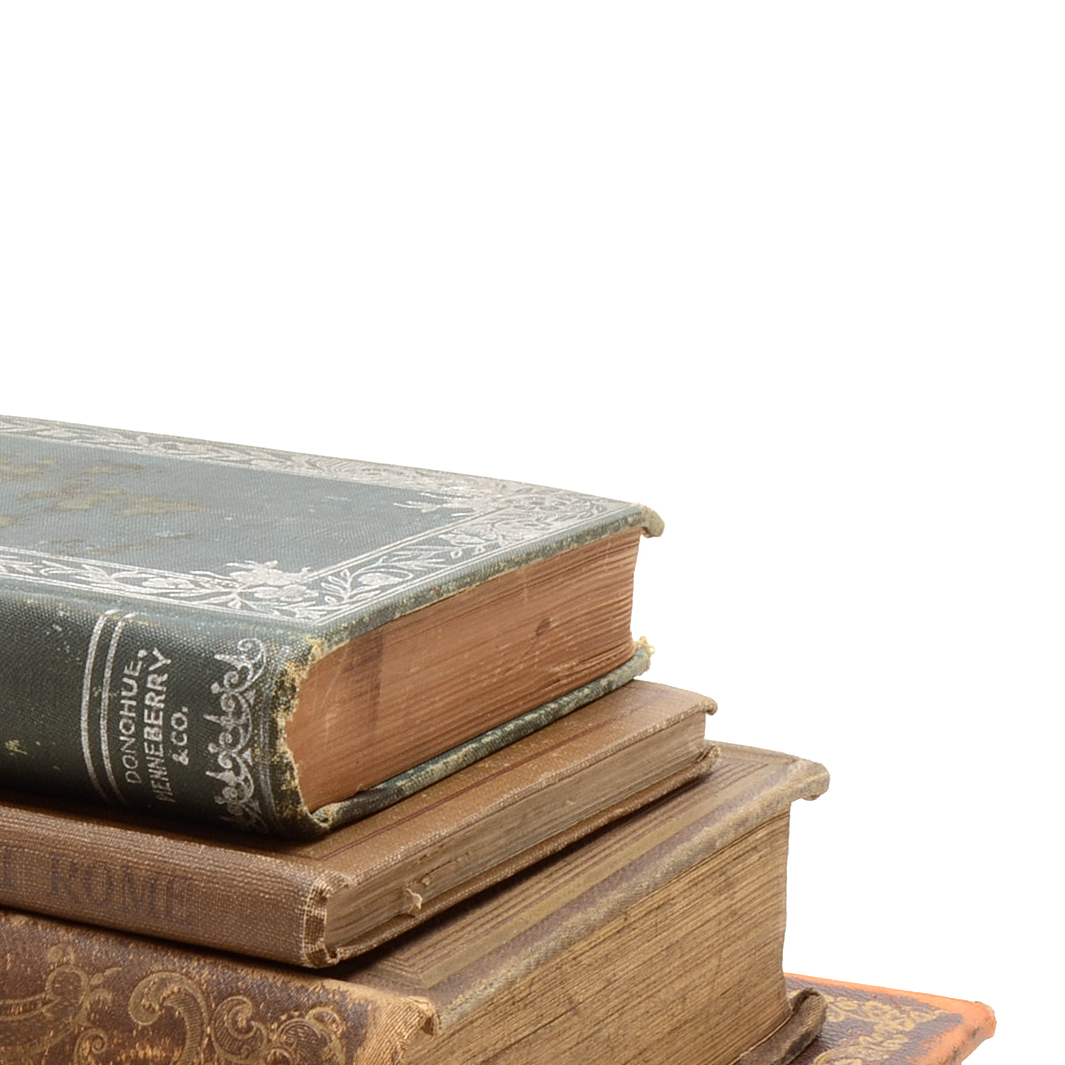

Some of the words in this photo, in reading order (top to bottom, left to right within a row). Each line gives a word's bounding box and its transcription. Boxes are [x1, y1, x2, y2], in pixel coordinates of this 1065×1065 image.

[119, 649, 149, 784] DONOHUE,
[143, 647, 176, 803] HENNEBERRY
[49, 854, 193, 923] ROME
